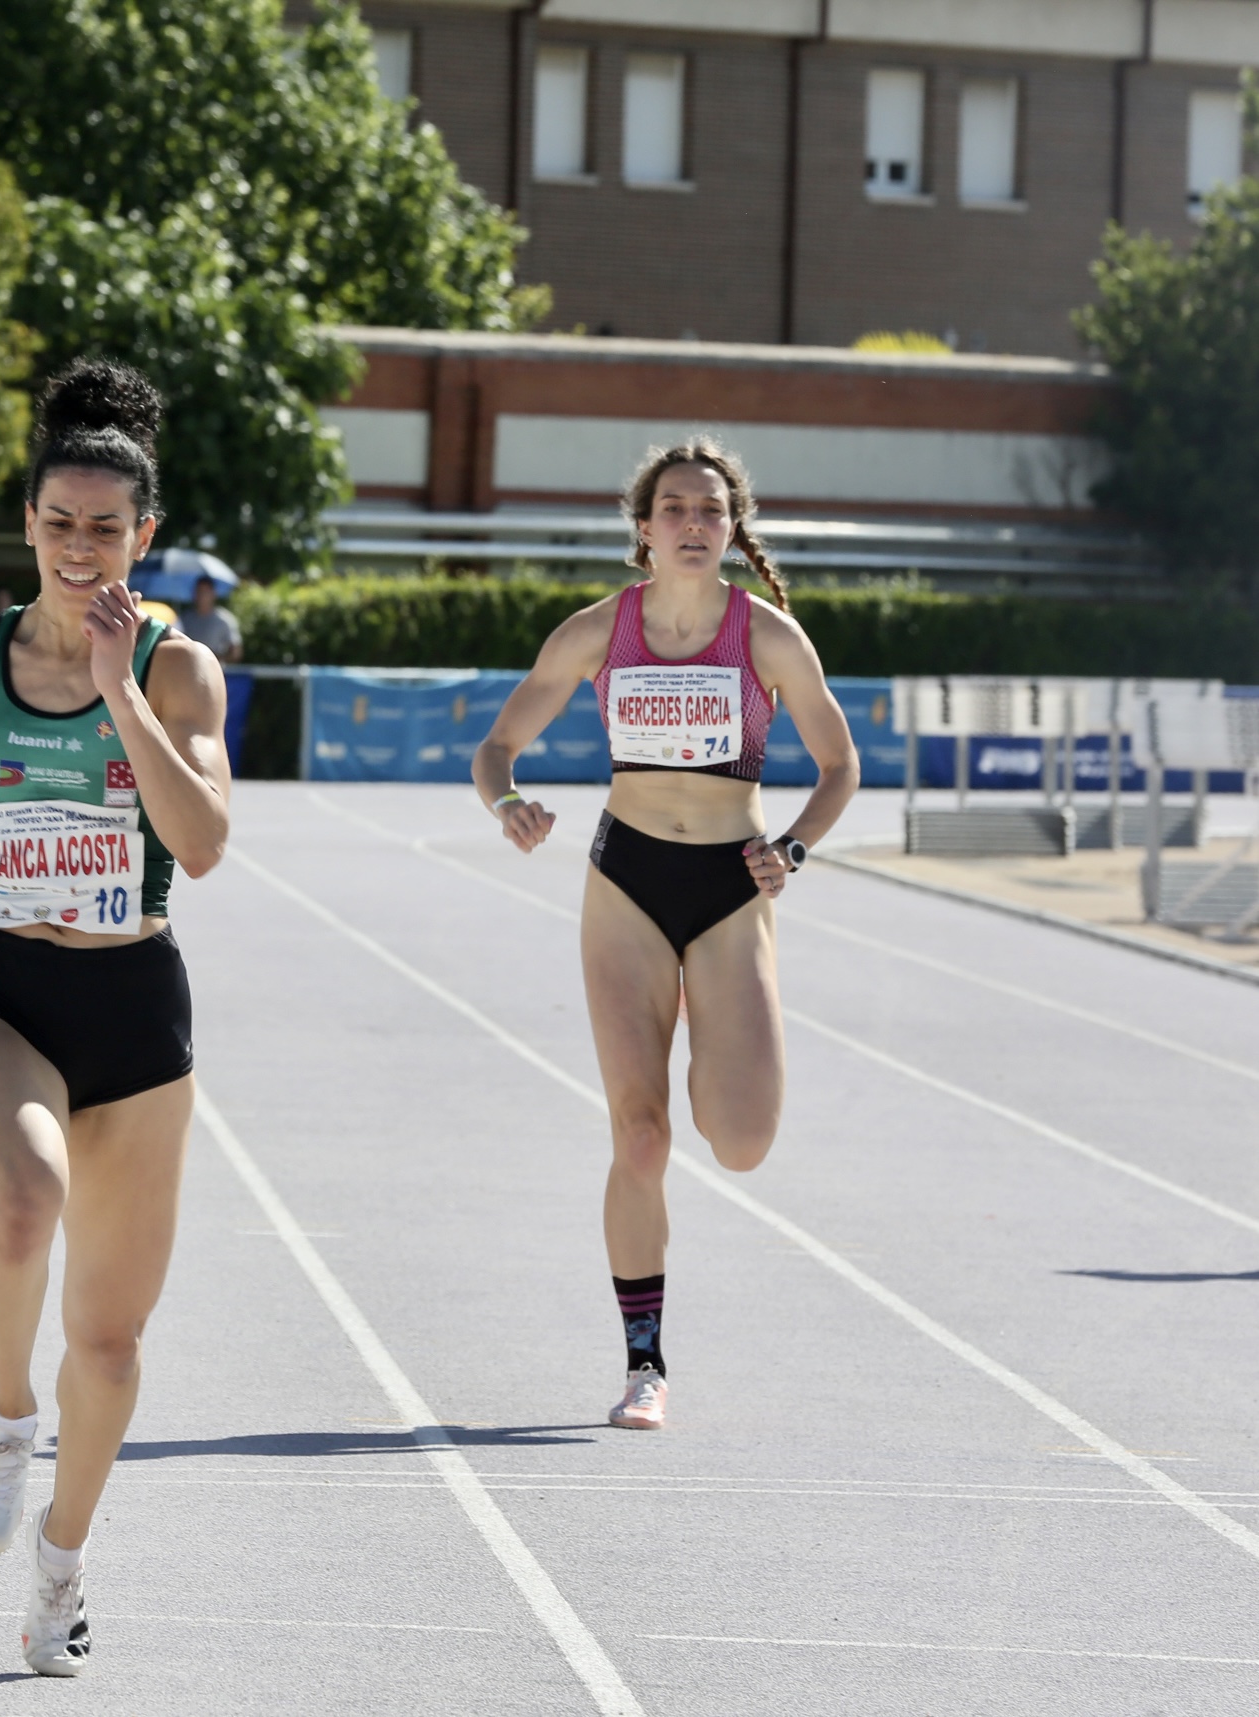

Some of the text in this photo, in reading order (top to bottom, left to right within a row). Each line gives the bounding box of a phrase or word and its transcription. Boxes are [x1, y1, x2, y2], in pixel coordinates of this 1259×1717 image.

[618, 695, 731, 726] MERCEDES GARCIA
[7, 731, 63, 750] luanvi
[704, 735, 730, 758] 74
[55, 833, 130, 877] ACOSTA
[95, 886, 128, 925] 10
